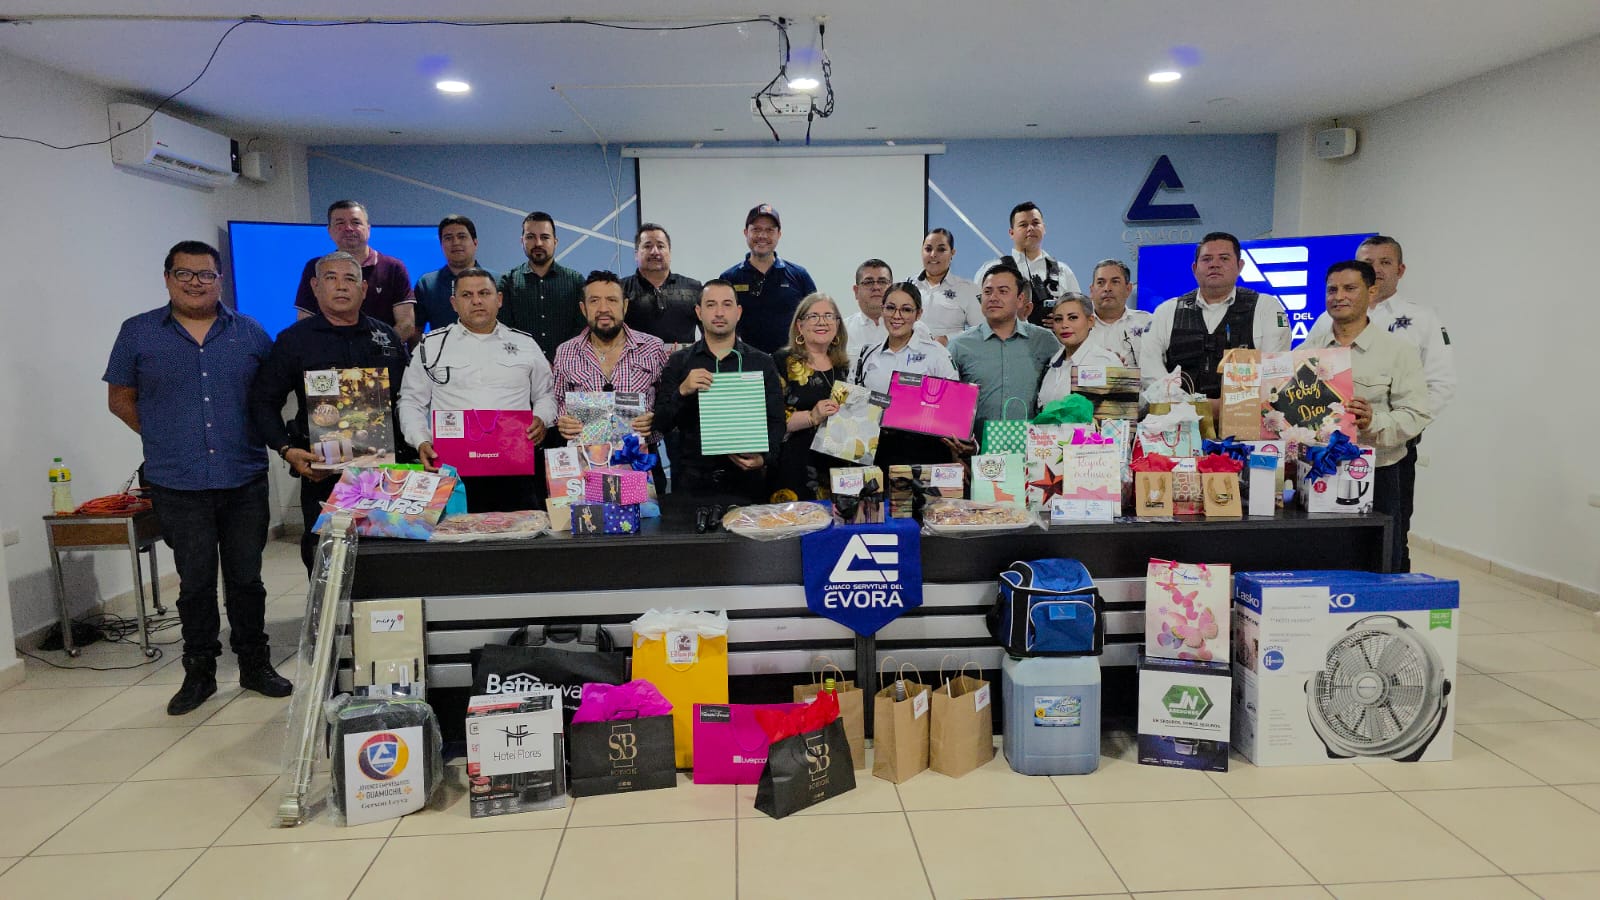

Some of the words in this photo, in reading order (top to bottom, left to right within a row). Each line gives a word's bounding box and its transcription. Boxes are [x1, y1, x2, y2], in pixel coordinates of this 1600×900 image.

[1122, 228, 1193, 243] CANACO
[1293, 312, 1315, 320] DEL
[354, 498, 428, 515] EARS
[824, 591, 904, 609] EVORA
[1236, 586, 1260, 608] Lasko
[494, 751, 516, 761] Hotel
[517, 749, 542, 760] Flores
